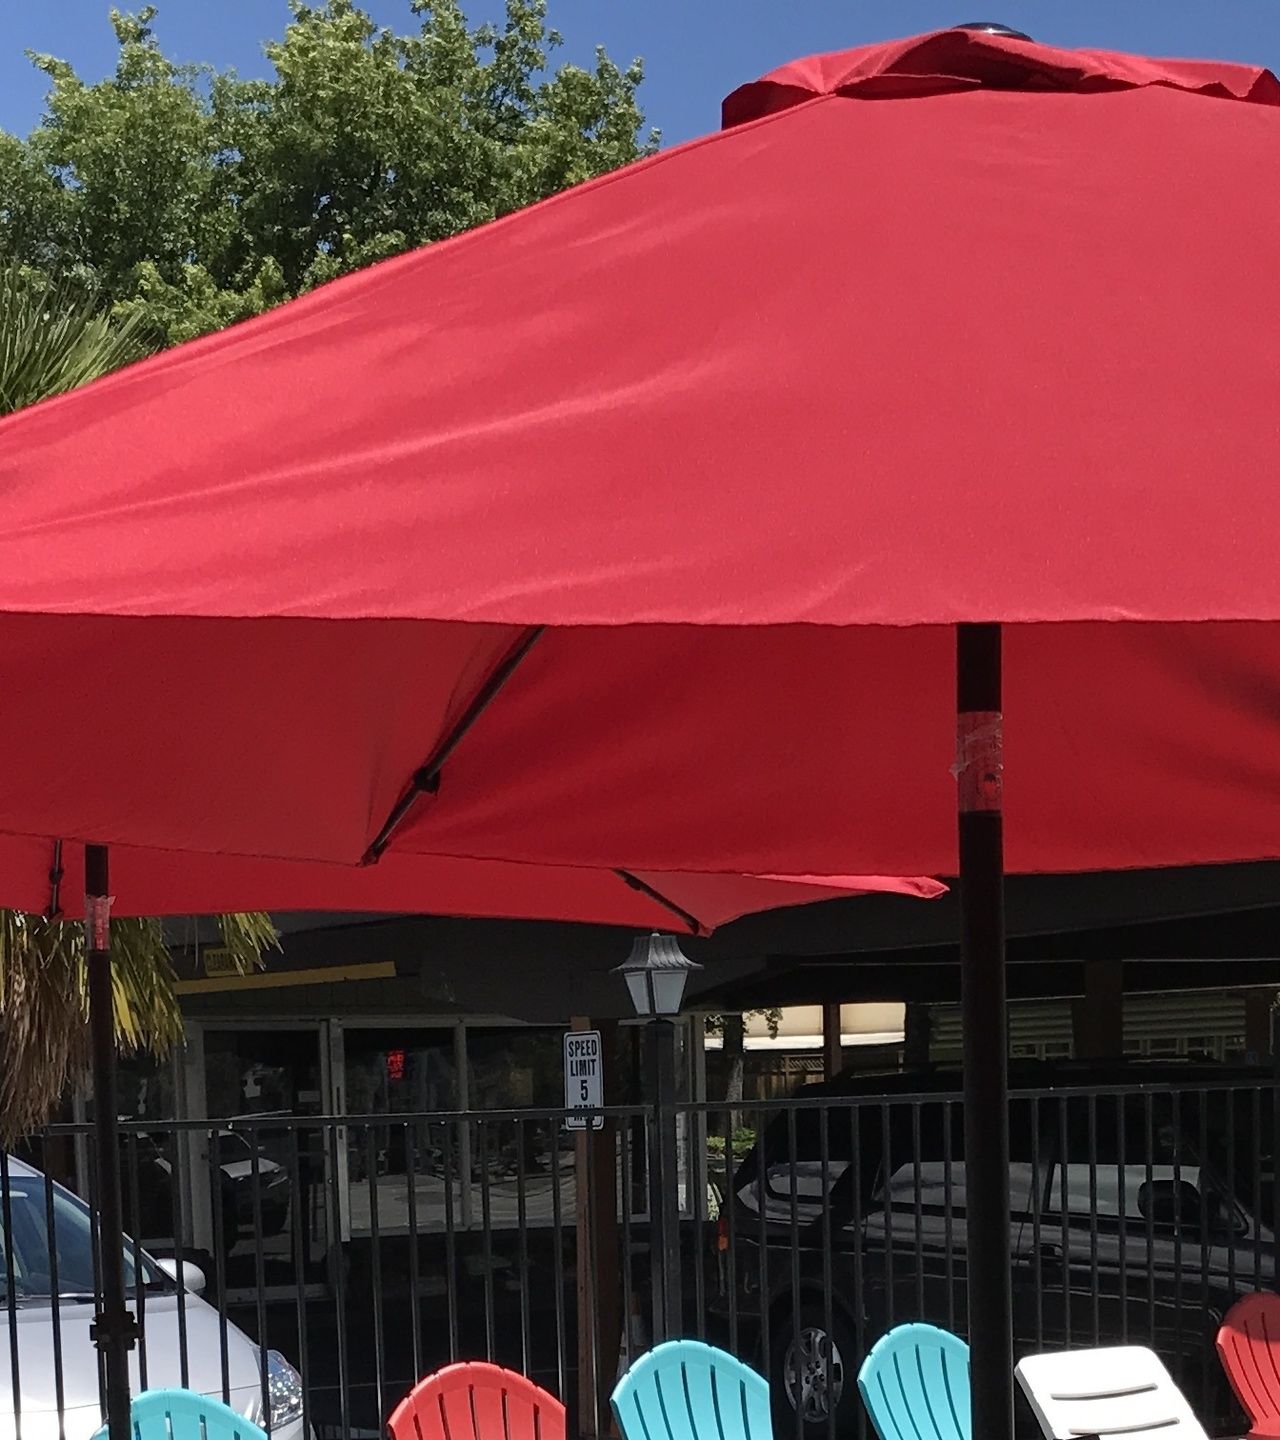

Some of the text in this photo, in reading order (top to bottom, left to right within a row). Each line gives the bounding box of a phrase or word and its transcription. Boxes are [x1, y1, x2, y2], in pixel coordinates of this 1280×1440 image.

[568, 1040, 597, 1057] SPEED
[570, 1059, 596, 1077] LIMIT
[580, 1079, 589, 1101] 5
